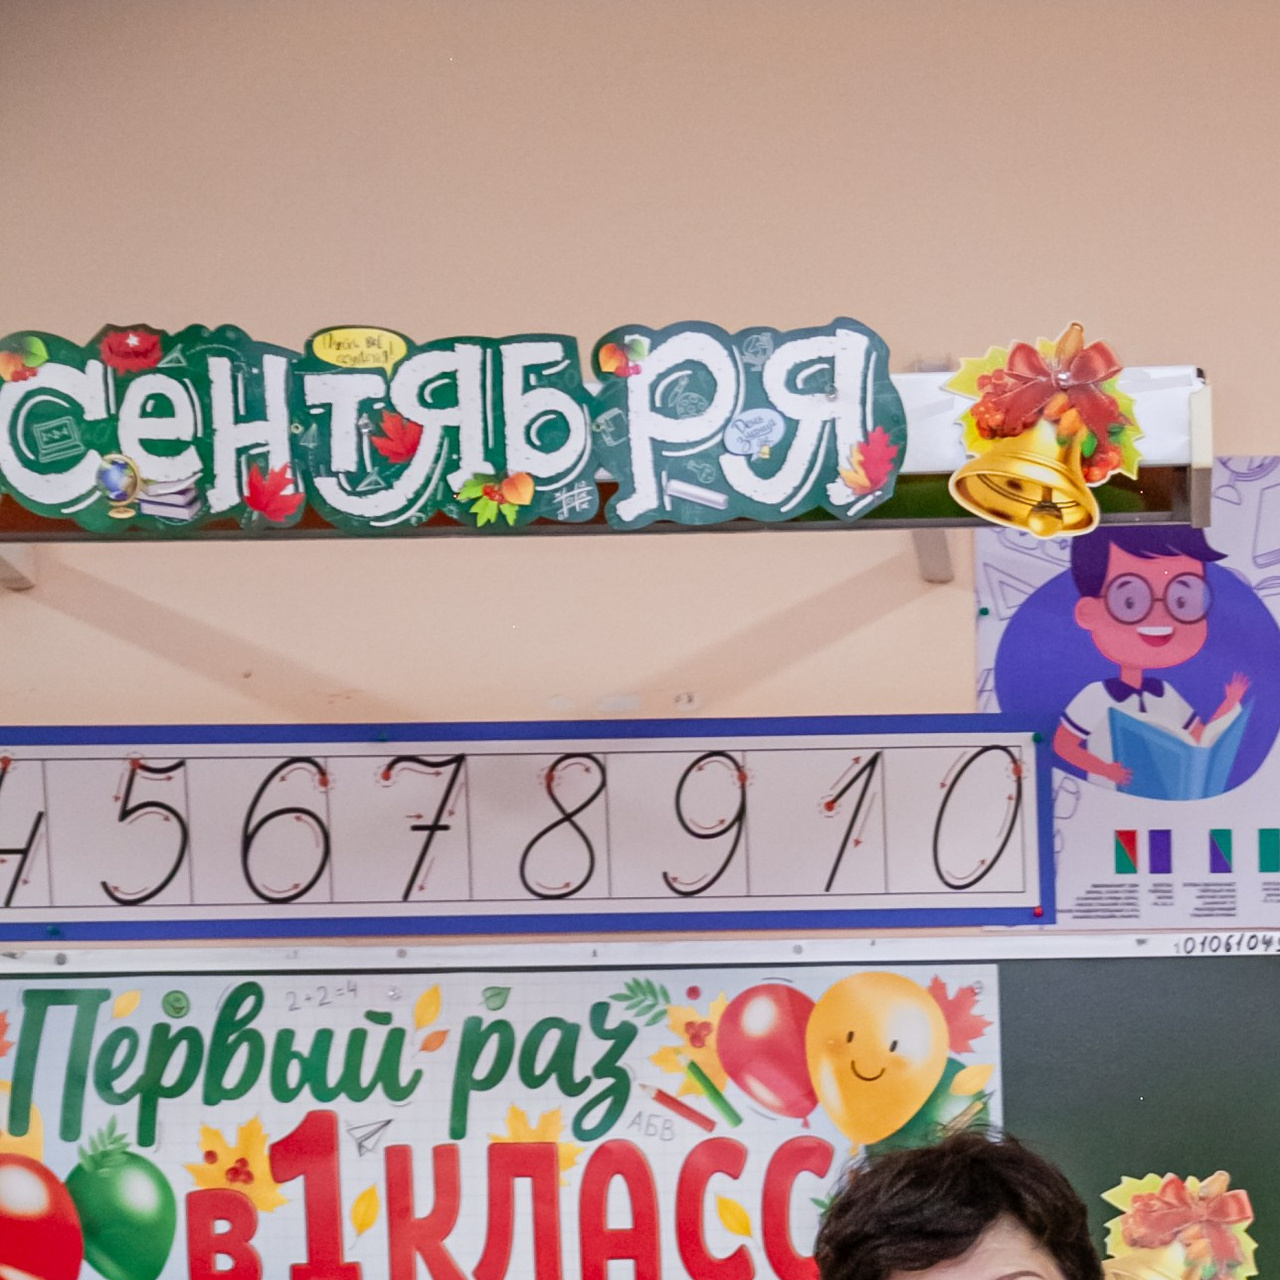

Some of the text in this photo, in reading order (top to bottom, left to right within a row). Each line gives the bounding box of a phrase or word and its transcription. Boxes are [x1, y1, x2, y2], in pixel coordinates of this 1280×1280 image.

[101, 758, 189, 905] 5
[241, 757, 331, 903] 6
[382, 752, 466, 900] 7
[519, 753, 606, 900] 8
[662, 751, 747, 896] 9
[8, 981, 638, 1147] Первый раз
[626, 1110, 676, 1142] АБВ
